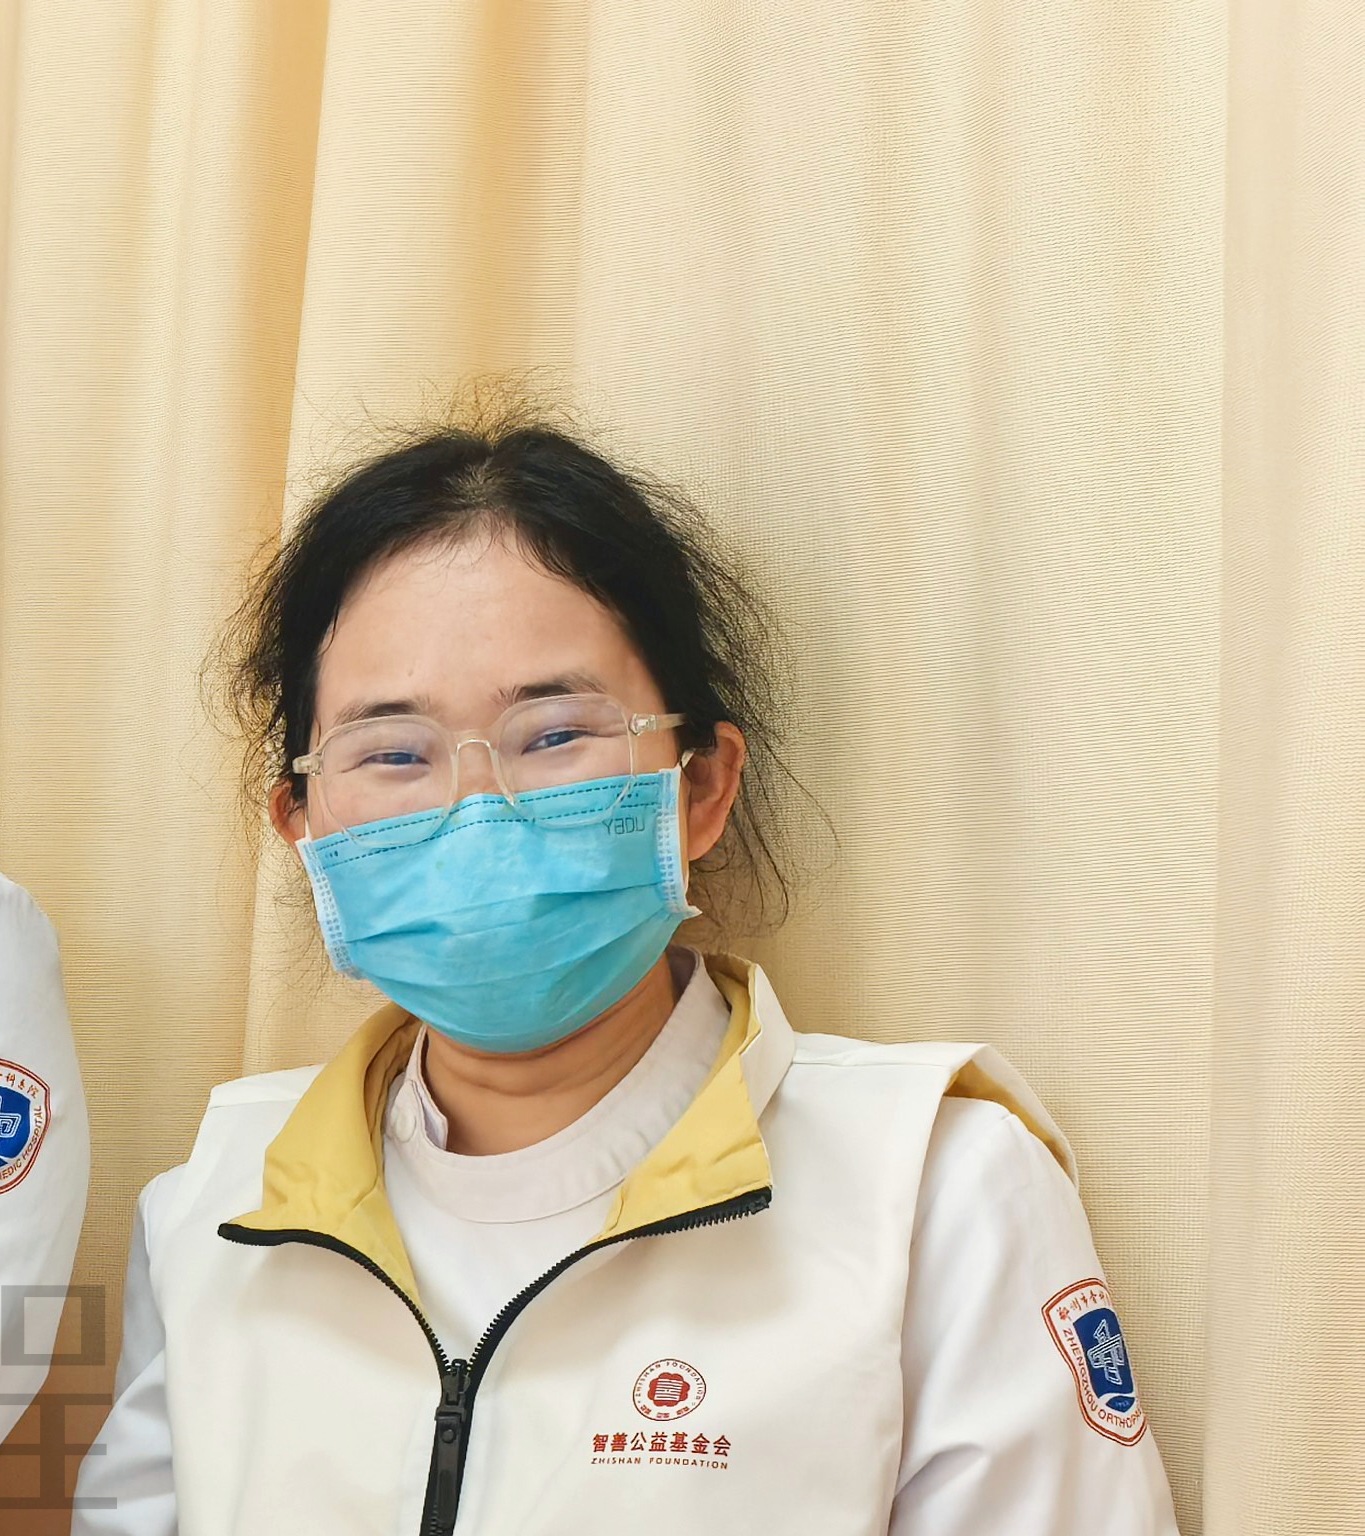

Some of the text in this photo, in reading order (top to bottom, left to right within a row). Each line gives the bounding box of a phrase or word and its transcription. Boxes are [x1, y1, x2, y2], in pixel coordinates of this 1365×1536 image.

[22, 1105, 43, 1161] HOSPITAL
[1062, 1327, 1098, 1412] ZHENGZHOU
[590, 1456, 729, 1470] ZHISHAN FOUNDATION
[592, 1431, 732, 1457] 智善公益基金会
